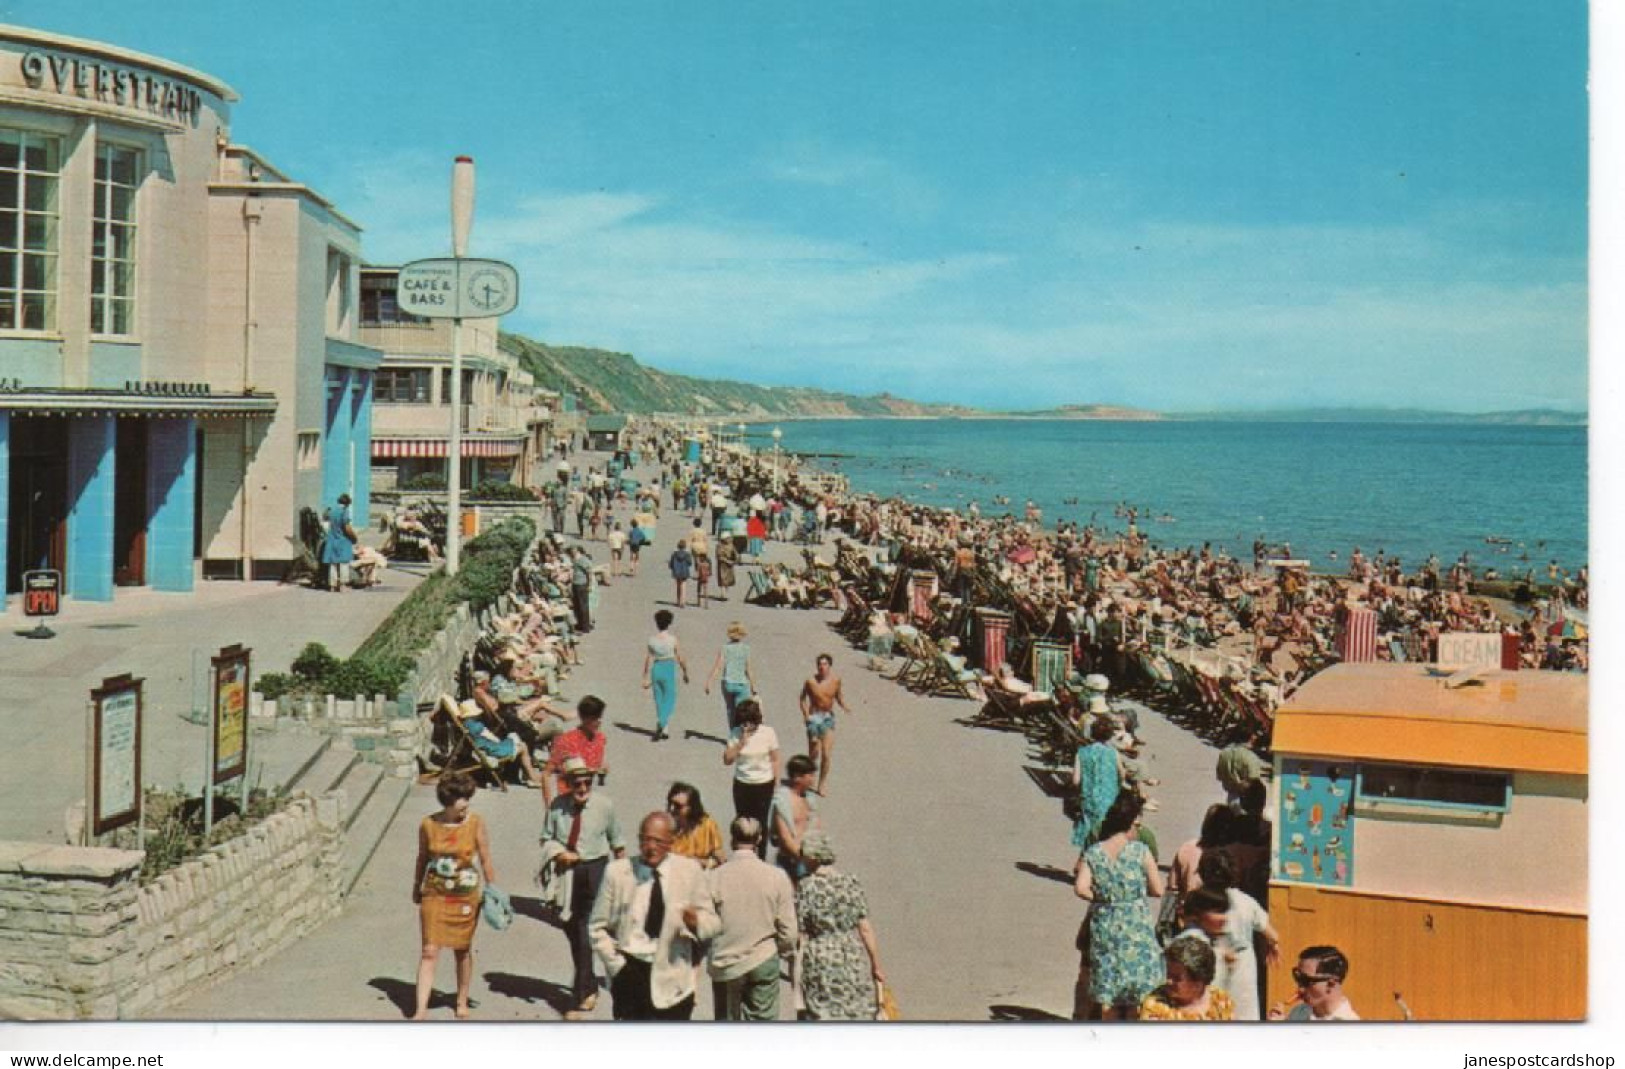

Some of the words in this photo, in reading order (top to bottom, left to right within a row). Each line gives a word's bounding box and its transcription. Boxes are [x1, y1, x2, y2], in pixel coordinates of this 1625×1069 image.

[22, 51, 201, 124] OVERSTRAND
[442, 280, 452, 291] &
[410, 293, 446, 305] BARS
[1441, 637, 1500, 666] CREAM
